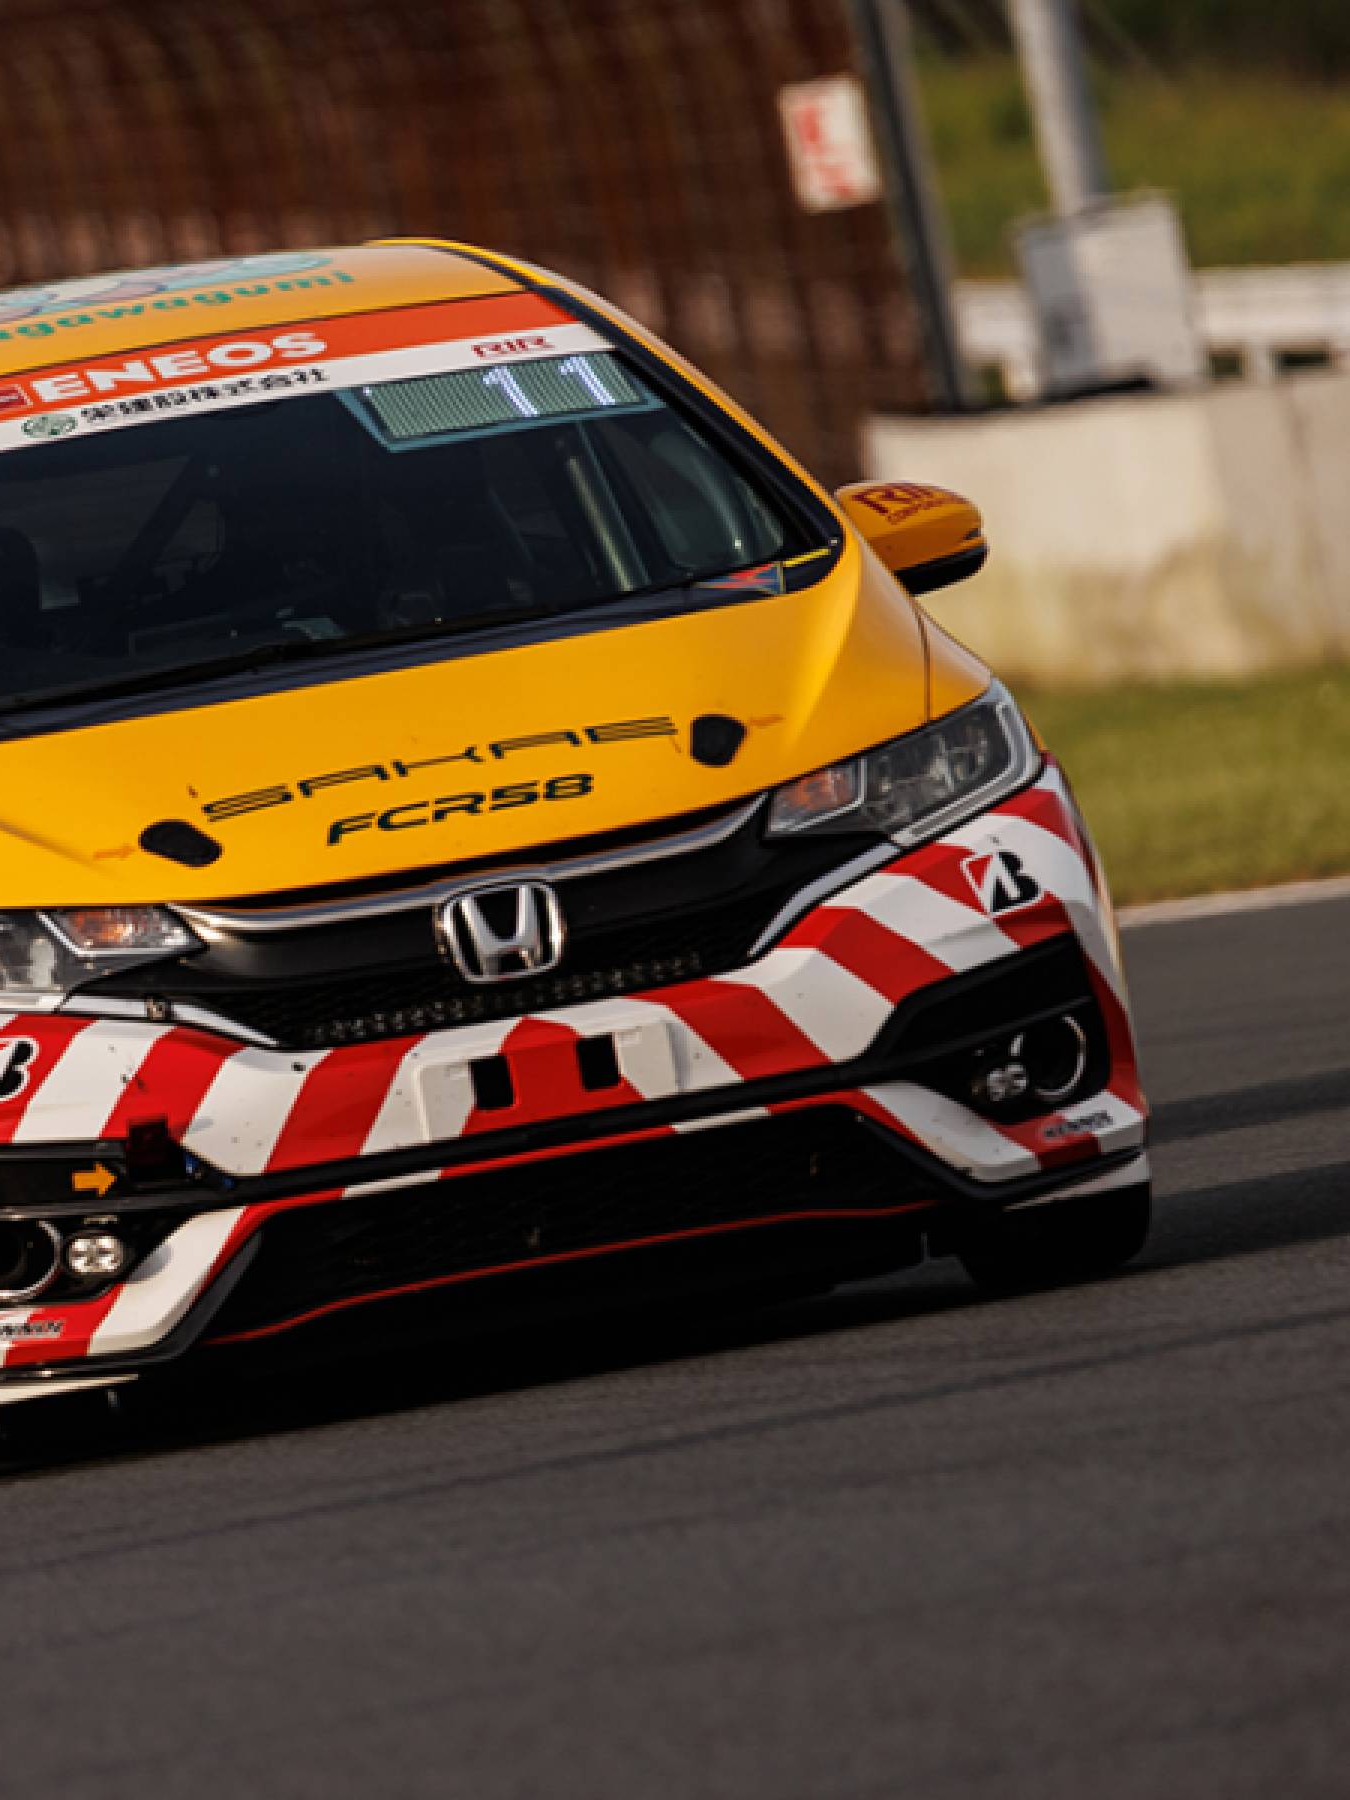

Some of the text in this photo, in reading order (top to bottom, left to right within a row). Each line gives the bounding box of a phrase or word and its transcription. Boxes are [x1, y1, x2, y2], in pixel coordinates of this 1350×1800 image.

[31, 331, 328, 404] ENEOS
[471, 336, 555, 360] RIR
[482, 356, 616, 417] 11
[202, 716, 678, 822] SAKAE
[327, 774, 595, 846] FCR58
